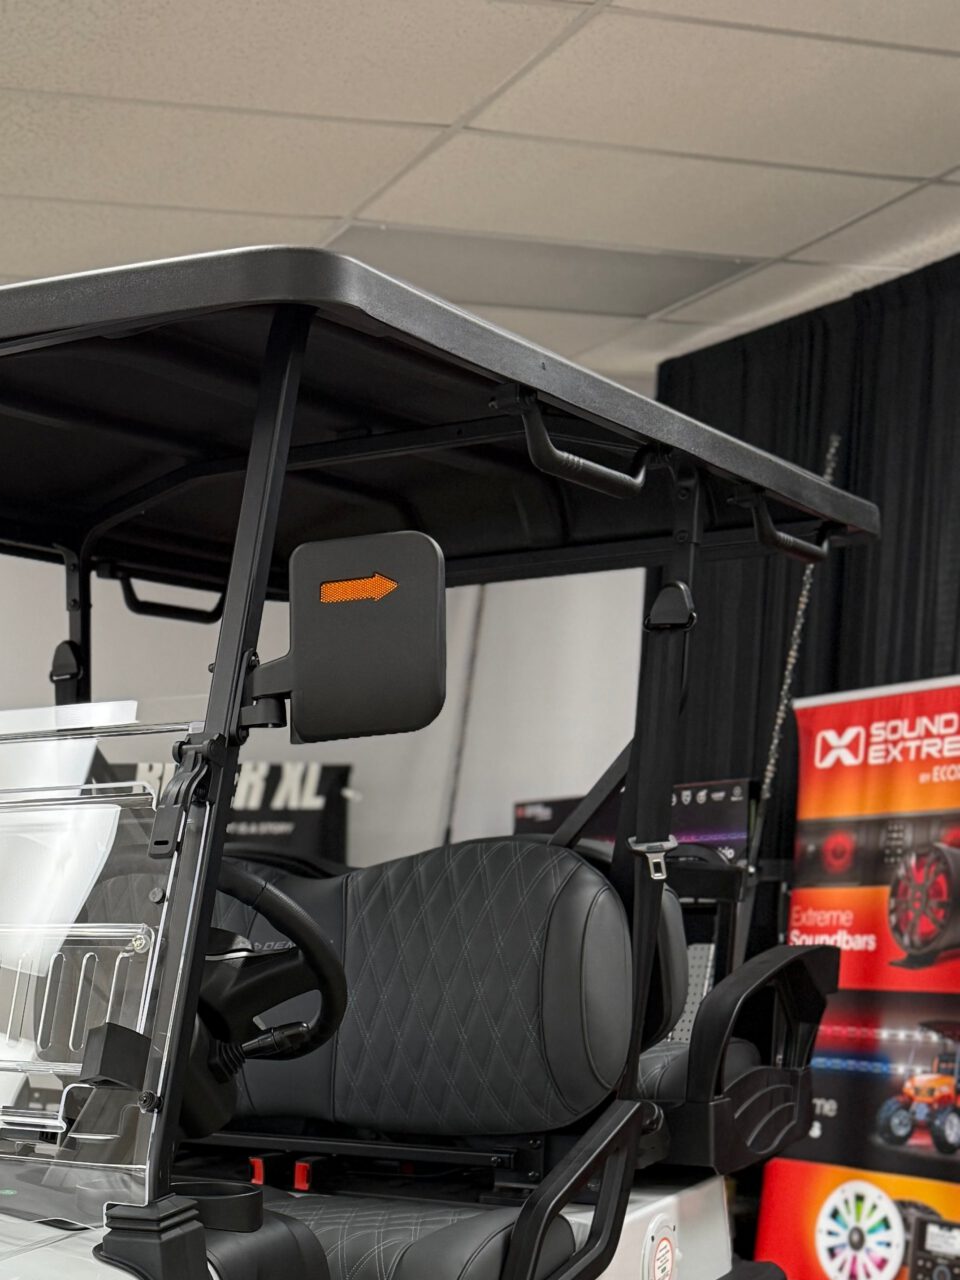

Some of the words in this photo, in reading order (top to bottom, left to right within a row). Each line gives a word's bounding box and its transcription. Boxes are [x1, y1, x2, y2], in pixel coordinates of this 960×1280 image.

[869, 711, 959, 743] SOUND
[271, 762, 327, 810] XL
[791, 905, 853, 927] Extreme
[789, 929, 876, 952] Soundbars
